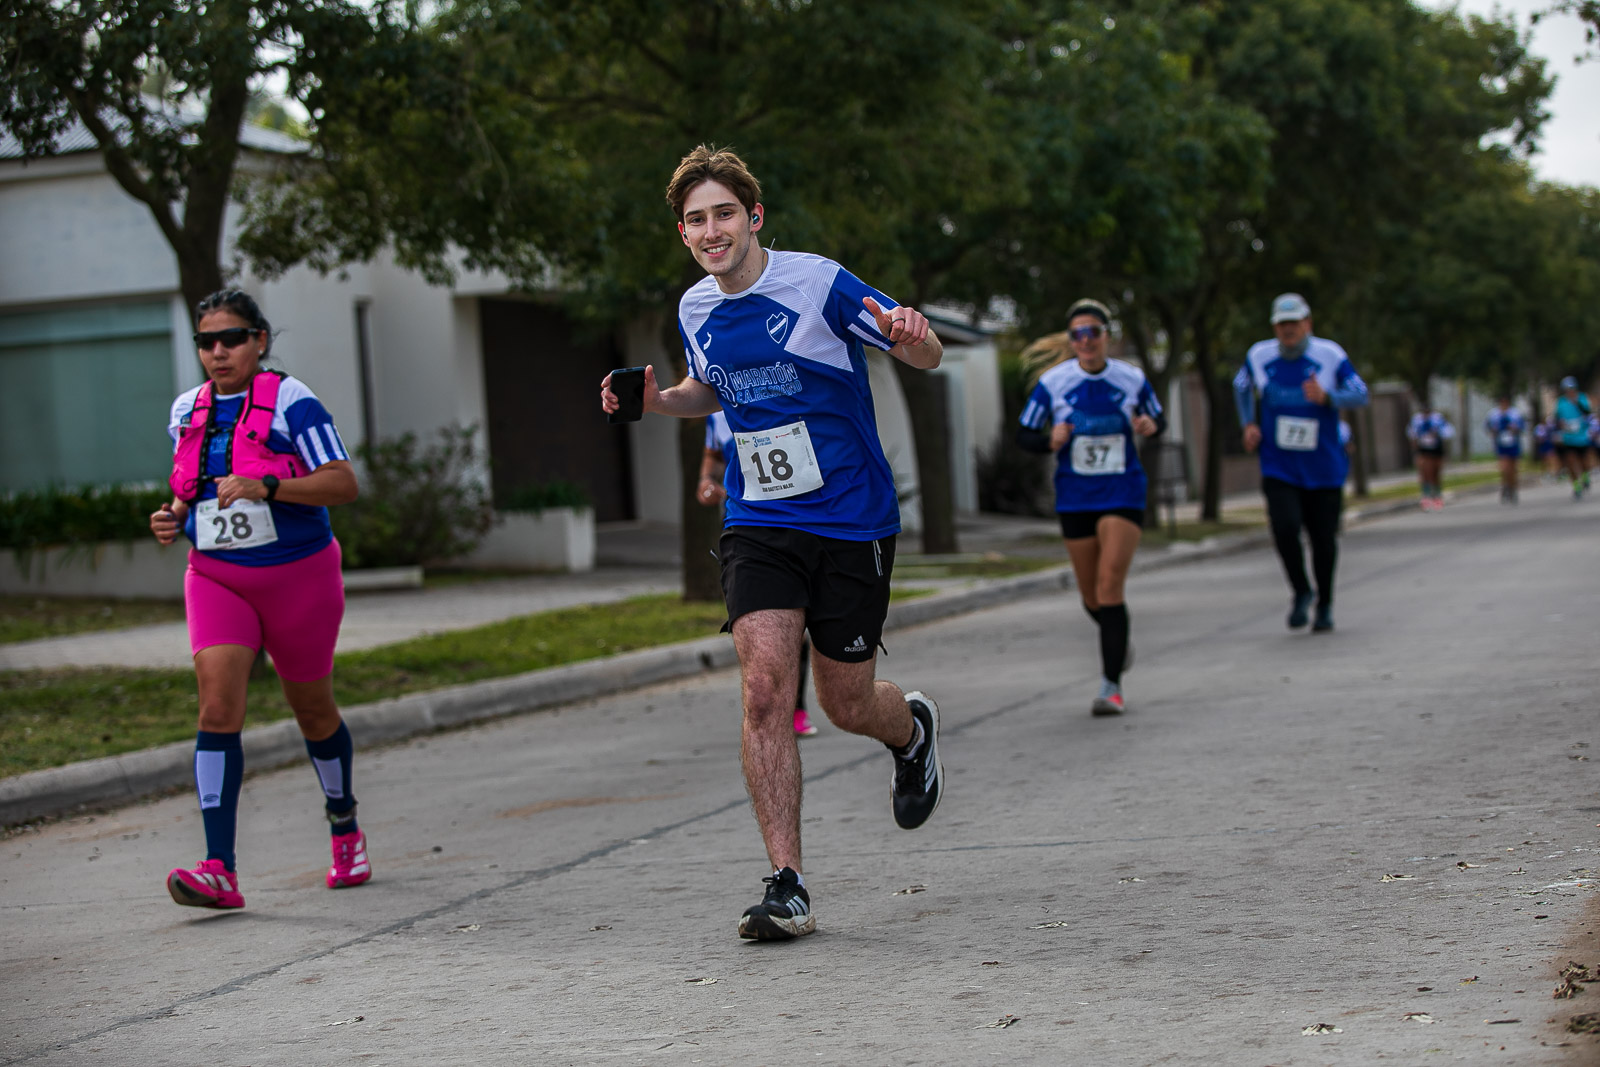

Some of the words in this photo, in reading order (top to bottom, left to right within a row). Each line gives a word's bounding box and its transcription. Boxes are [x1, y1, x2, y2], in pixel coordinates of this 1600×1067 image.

[707, 364, 738, 408] 3
[729, 361, 799, 391] MARATÓN
[751, 448, 794, 484] 18
[1085, 445, 1111, 467] 37
[213, 512, 253, 544] 28
